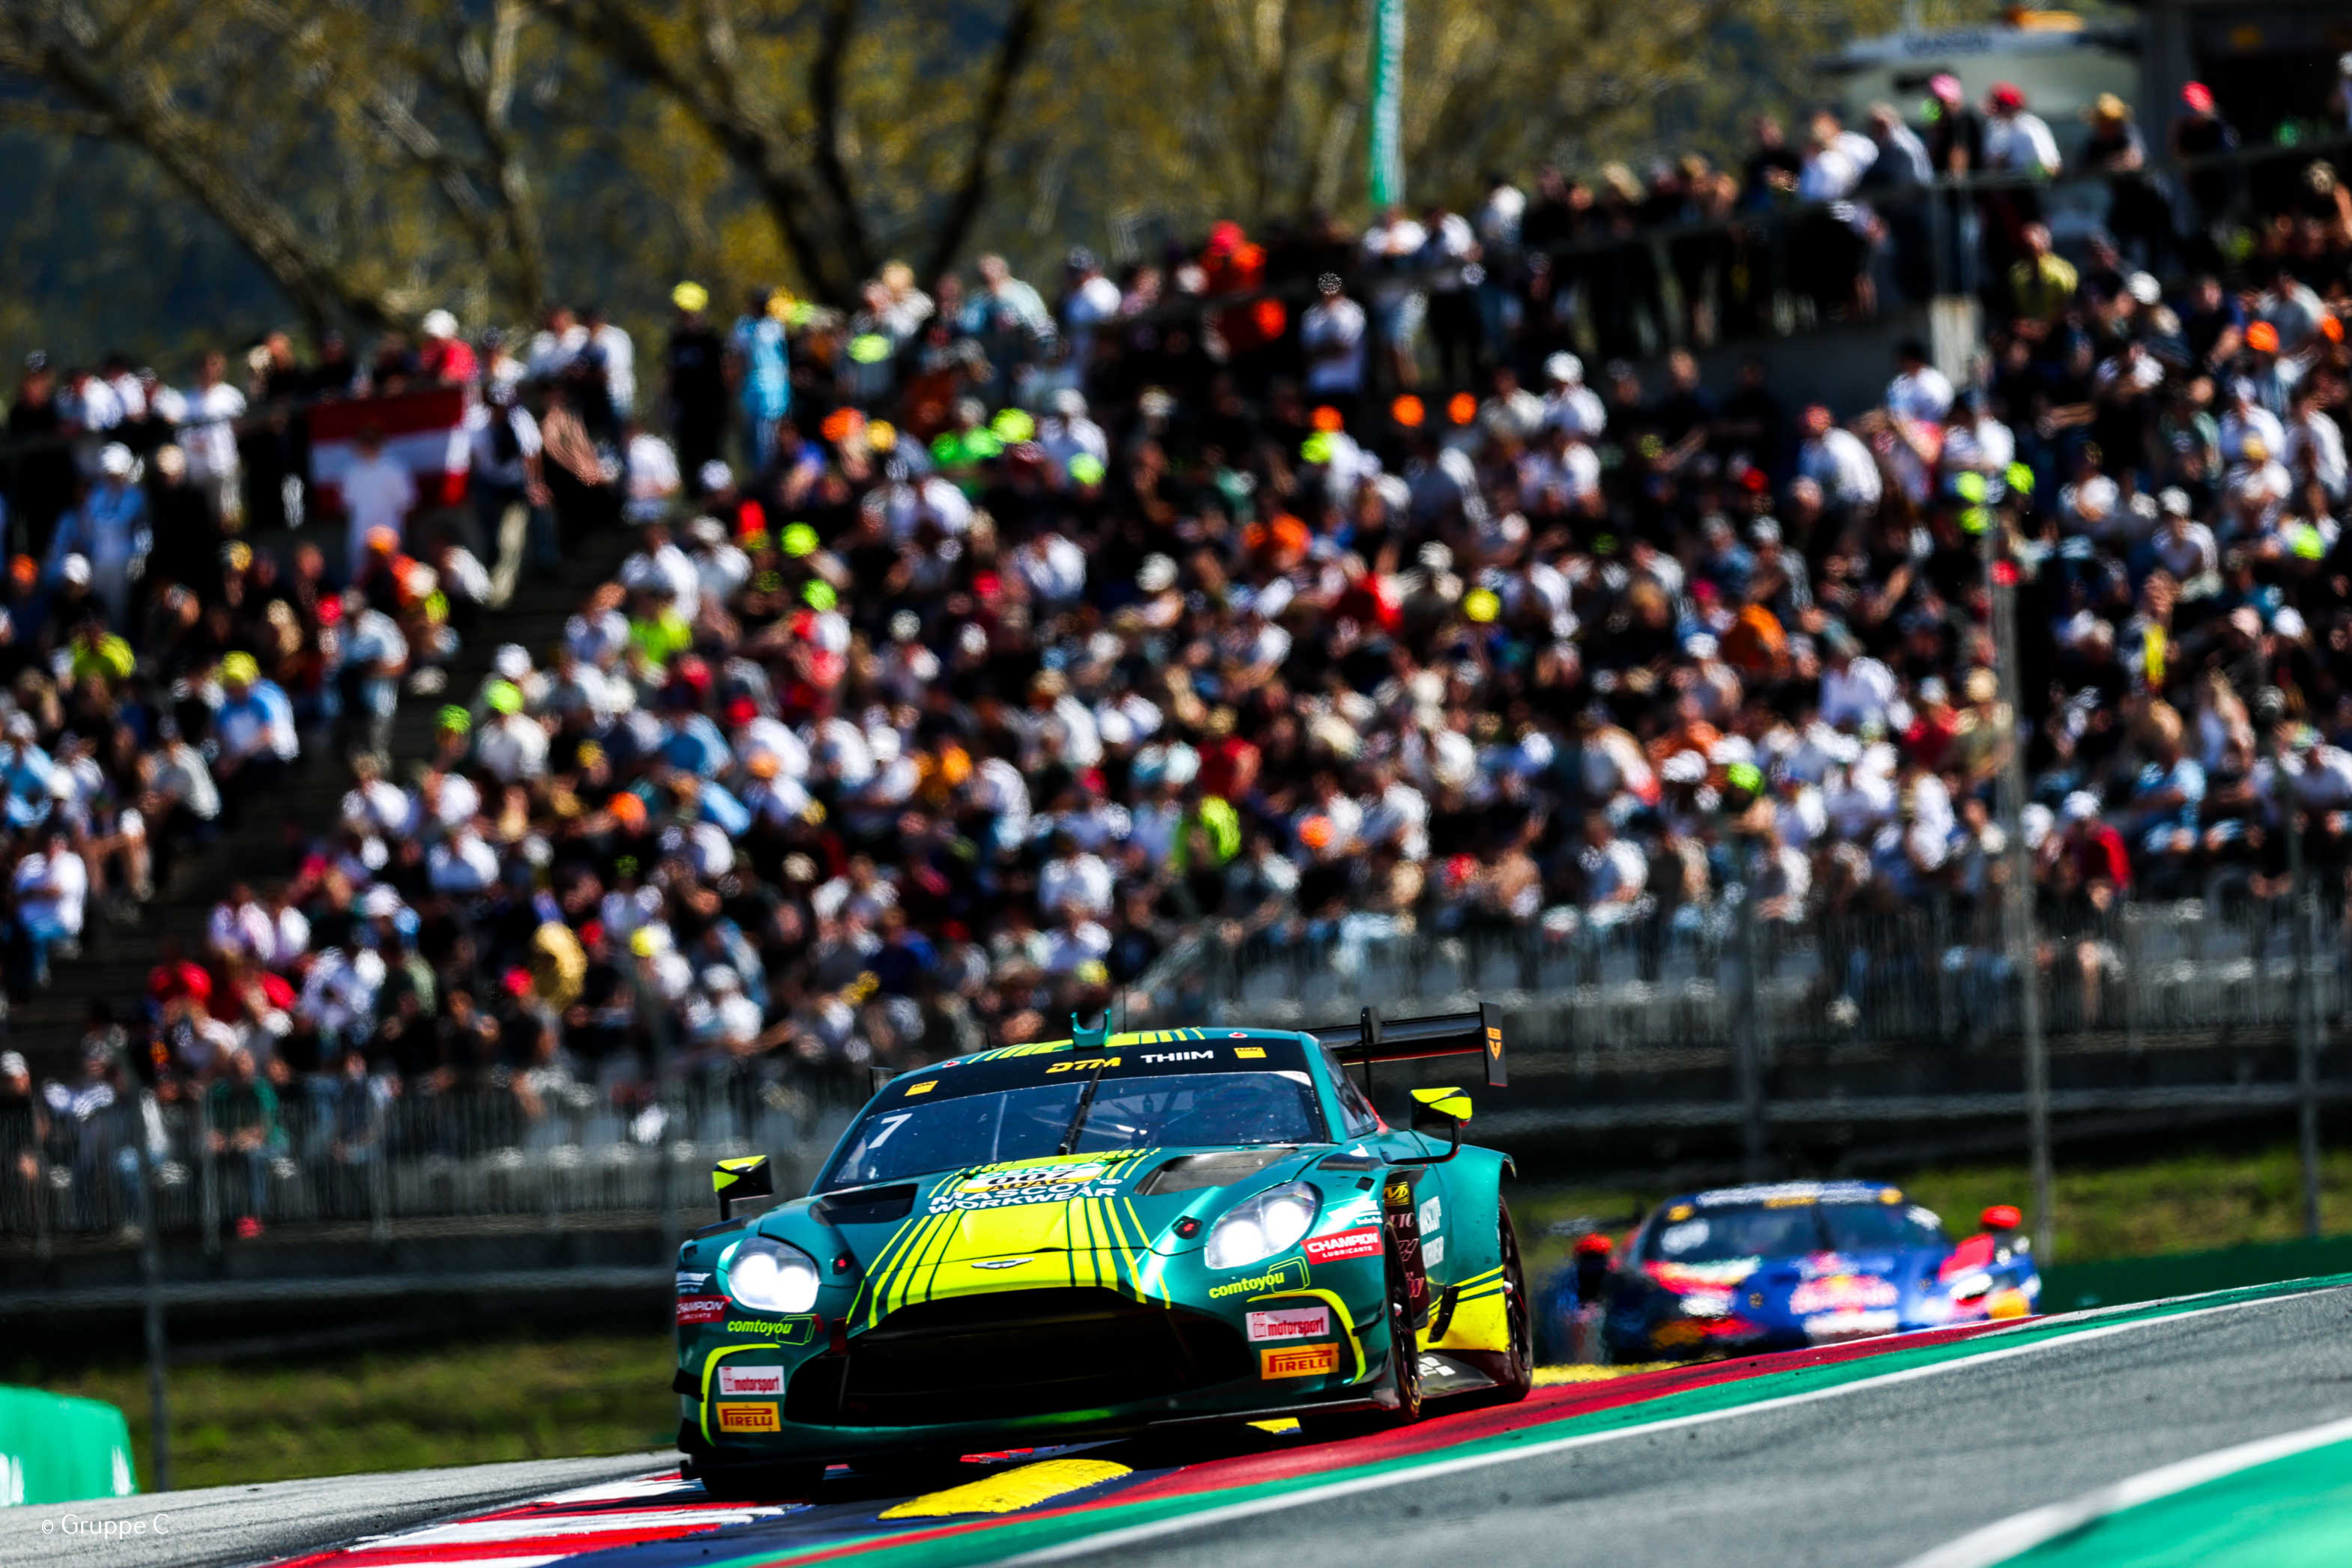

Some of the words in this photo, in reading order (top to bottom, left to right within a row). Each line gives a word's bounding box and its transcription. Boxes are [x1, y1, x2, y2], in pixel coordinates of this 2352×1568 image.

[1045, 1057, 1122, 1073] DTM
[1140, 1051, 1214, 1063] THIIM
[867, 1113, 913, 1149] 7
[986, 1178, 1071, 1192] ADAC
[988, 1170, 1076, 1185] 007
[929, 1186, 1117, 1214] WORKWEAR
[1307, 1233, 1378, 1253] CHAMPION
[1209, 1272, 1285, 1298] comtoyou
[727, 1319, 792, 1336] comtoyou
[1268, 1316, 1324, 1337] motorsport
[1268, 1349, 1332, 1373] PIRELLI
[721, 1409, 774, 1426] PIRELLI
